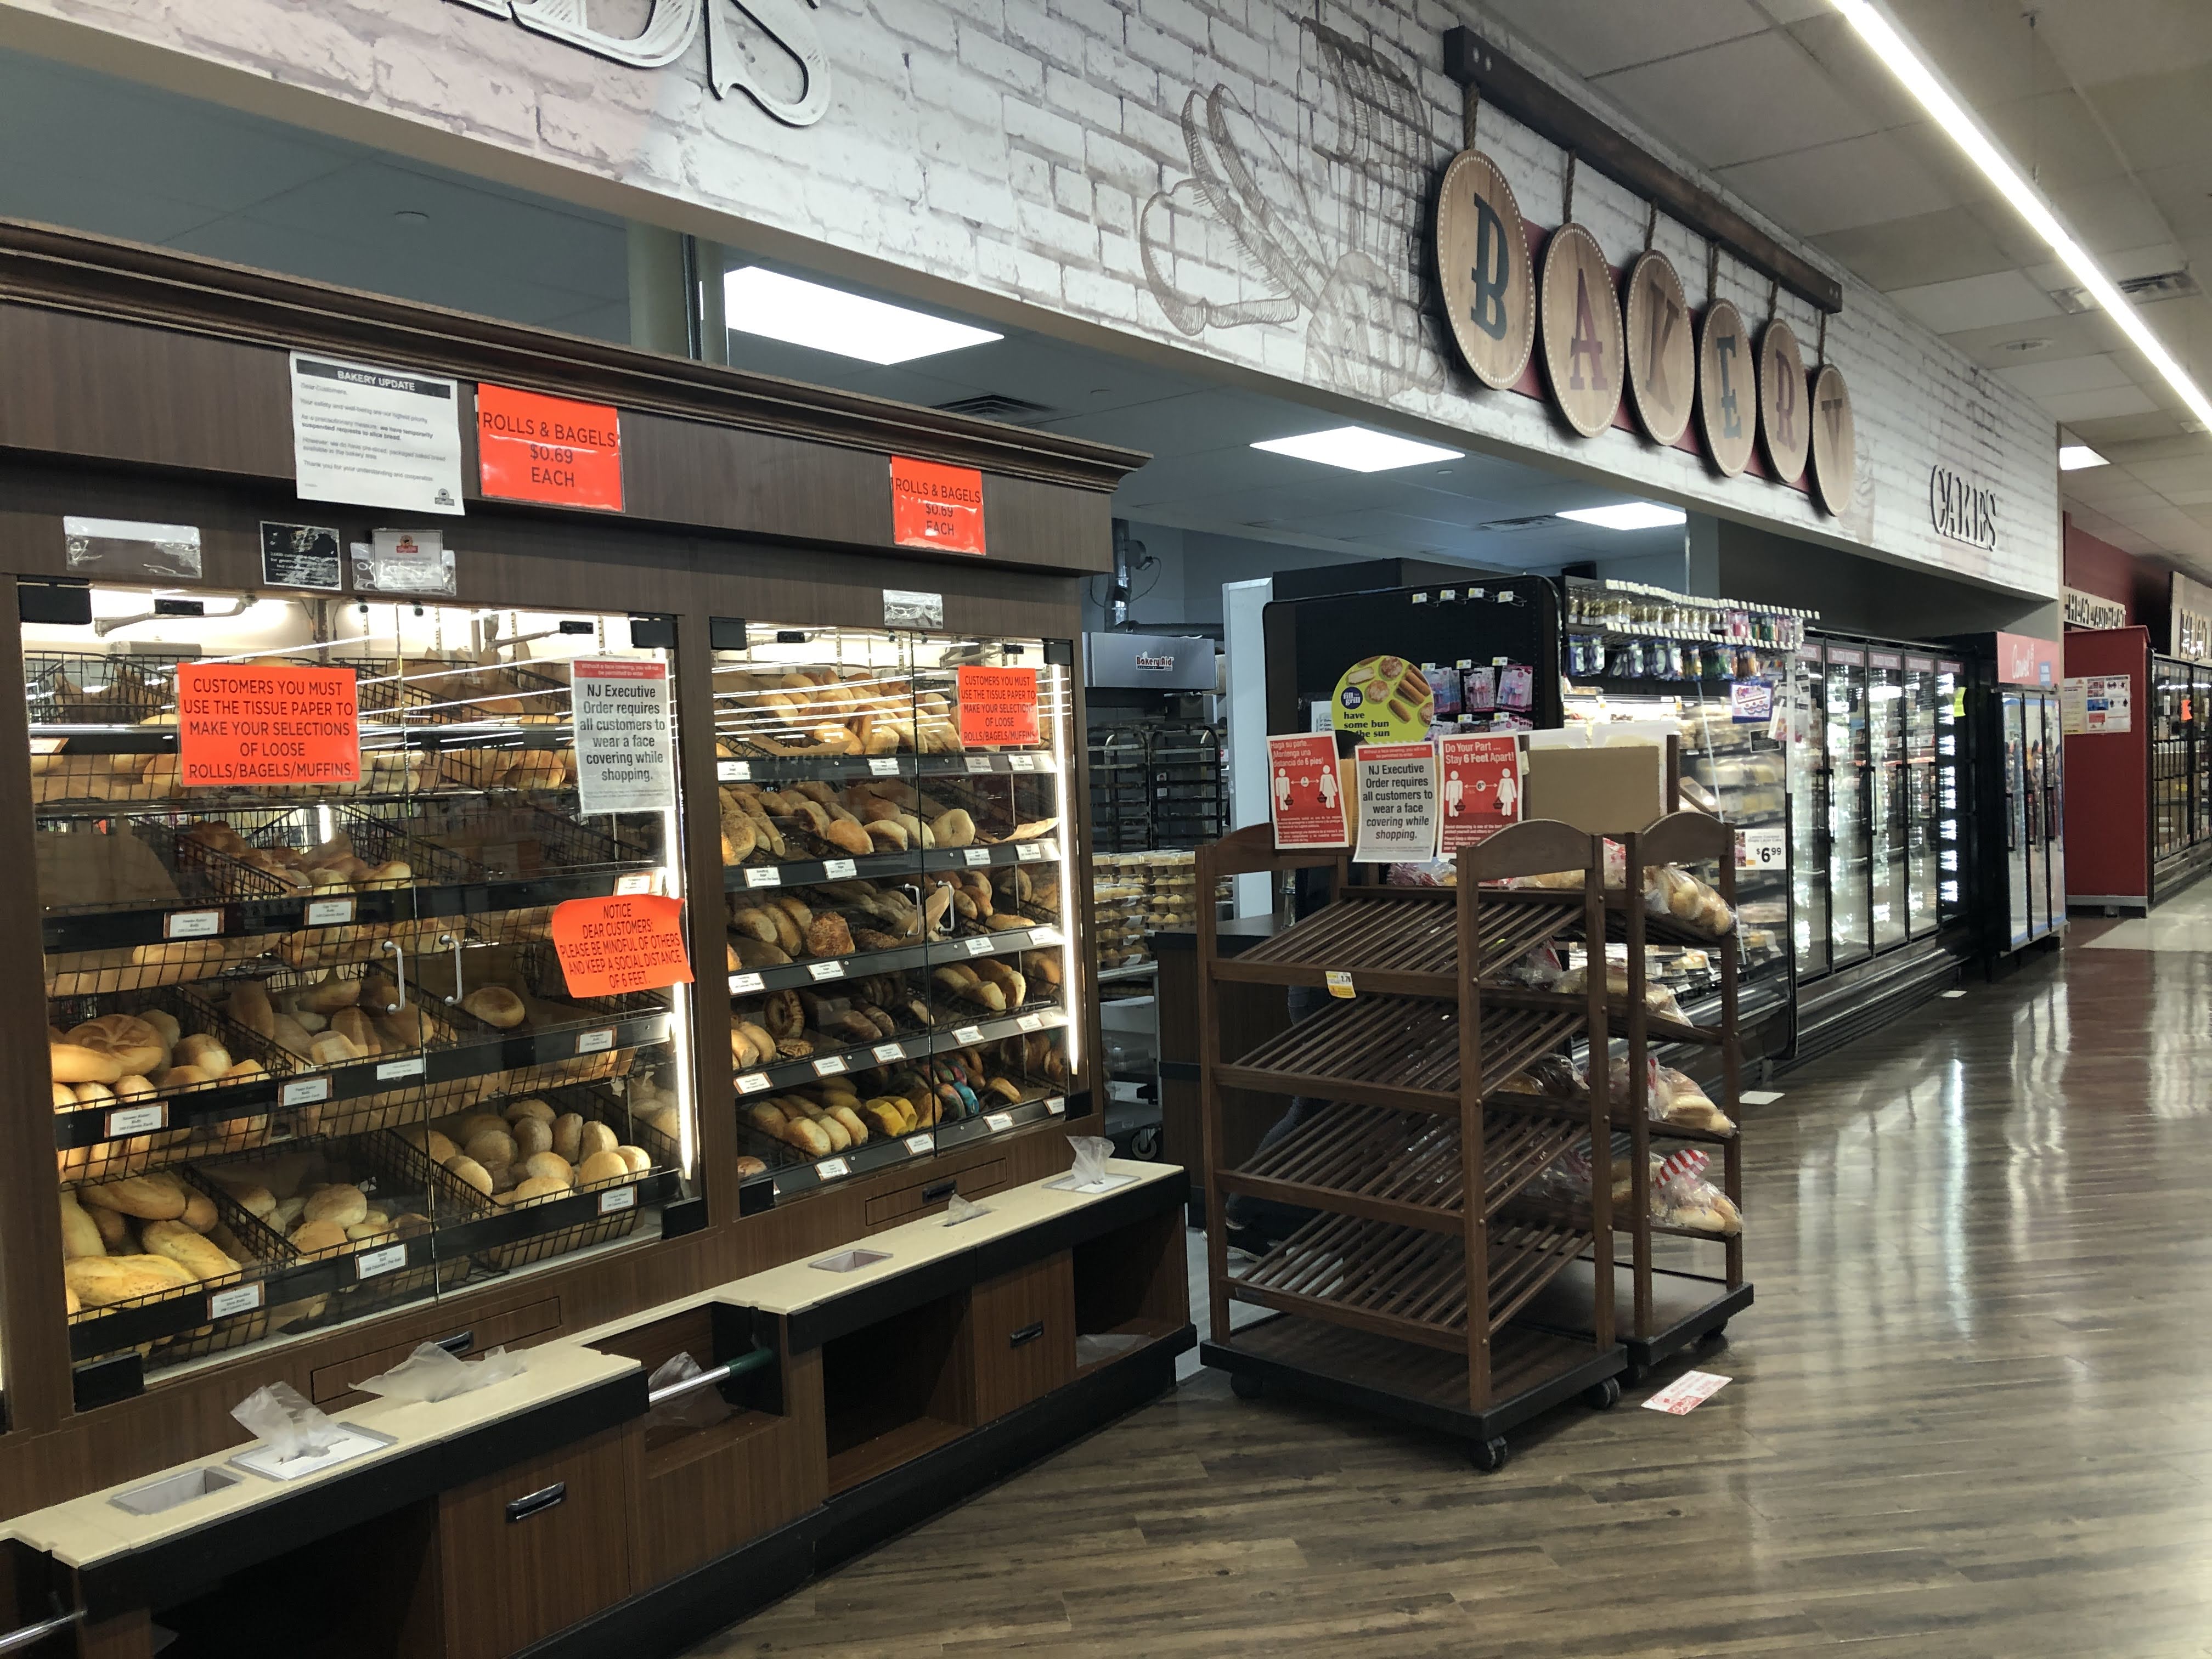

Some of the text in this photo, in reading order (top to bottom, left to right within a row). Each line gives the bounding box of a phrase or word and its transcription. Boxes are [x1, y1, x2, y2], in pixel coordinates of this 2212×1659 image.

[1471, 193, 1842, 464] BAKERY
[337, 370, 415, 391] BAKERY UPDATE
[483, 412, 616, 448] ROLLS & BAGELS
[530, 444, 573, 464] $0.69
[531, 466, 574, 488] EACH
[895, 477, 981, 504] ROLLS & BAGELS
[926, 503, 953, 517] $0.69
[1930, 464, 1996, 551] CAKES
[926, 521, 955, 536] EACH
[193, 678, 342, 696] CUSTOMERS YOU MUST
[965, 675, 1030, 686] CUSTOMERS YOU MUST
[587, 684, 656, 698] NJ Executive
[961, 690, 1035, 699] USE THE TISSUE PAPER TO
[183, 699, 353, 716] USE THE TISSUE PAPER TO
[584, 701, 660, 716] Order requires
[963, 703, 980, 713] MAKE
[981, 703, 998, 713] YOUR
[189, 721, 350, 737] MAKE YOUR SELECTIONS
[580, 718, 665, 731] all customers to
[985, 717, 1014, 727] OF LOOSE
[1372, 720, 1389, 728] bun
[593, 735, 654, 747] wear a face
[1445, 743, 1455, 753] Do
[1457, 742, 1474, 752] Your
[1475, 741, 1492, 752] Part
[240, 742, 306, 757] OF LOOSE
[586, 751, 663, 766] covering while
[1310, 757, 1324, 766] pies!
[1446, 752, 1515, 766] Stay 6 Feet Apart!
[189, 761, 354, 780] ROLLS/BAGELS/MUFFINS.
[601, 768, 653, 783] shopping.
[1368, 763, 1424, 775] NJ Executive
[1366, 777, 1429, 789] Order requires
[1363, 789, 1433, 801] all customers to
[1373, 803, 1423, 814] wear a face
[1366, 816, 1429, 828] covering while
[1375, 830, 1417, 841] shopping.
[603, 903, 631, 919] NOTICE
[582, 919, 653, 939] DEAR CUSTOMERS:
[560, 933, 680, 958] PLEASE BE MINDFUL OF OTHERS
[568, 950, 682, 975] AND KEEP A SOCIAL DISTANCE
[609, 970, 651, 989] OF 6 FEET.
